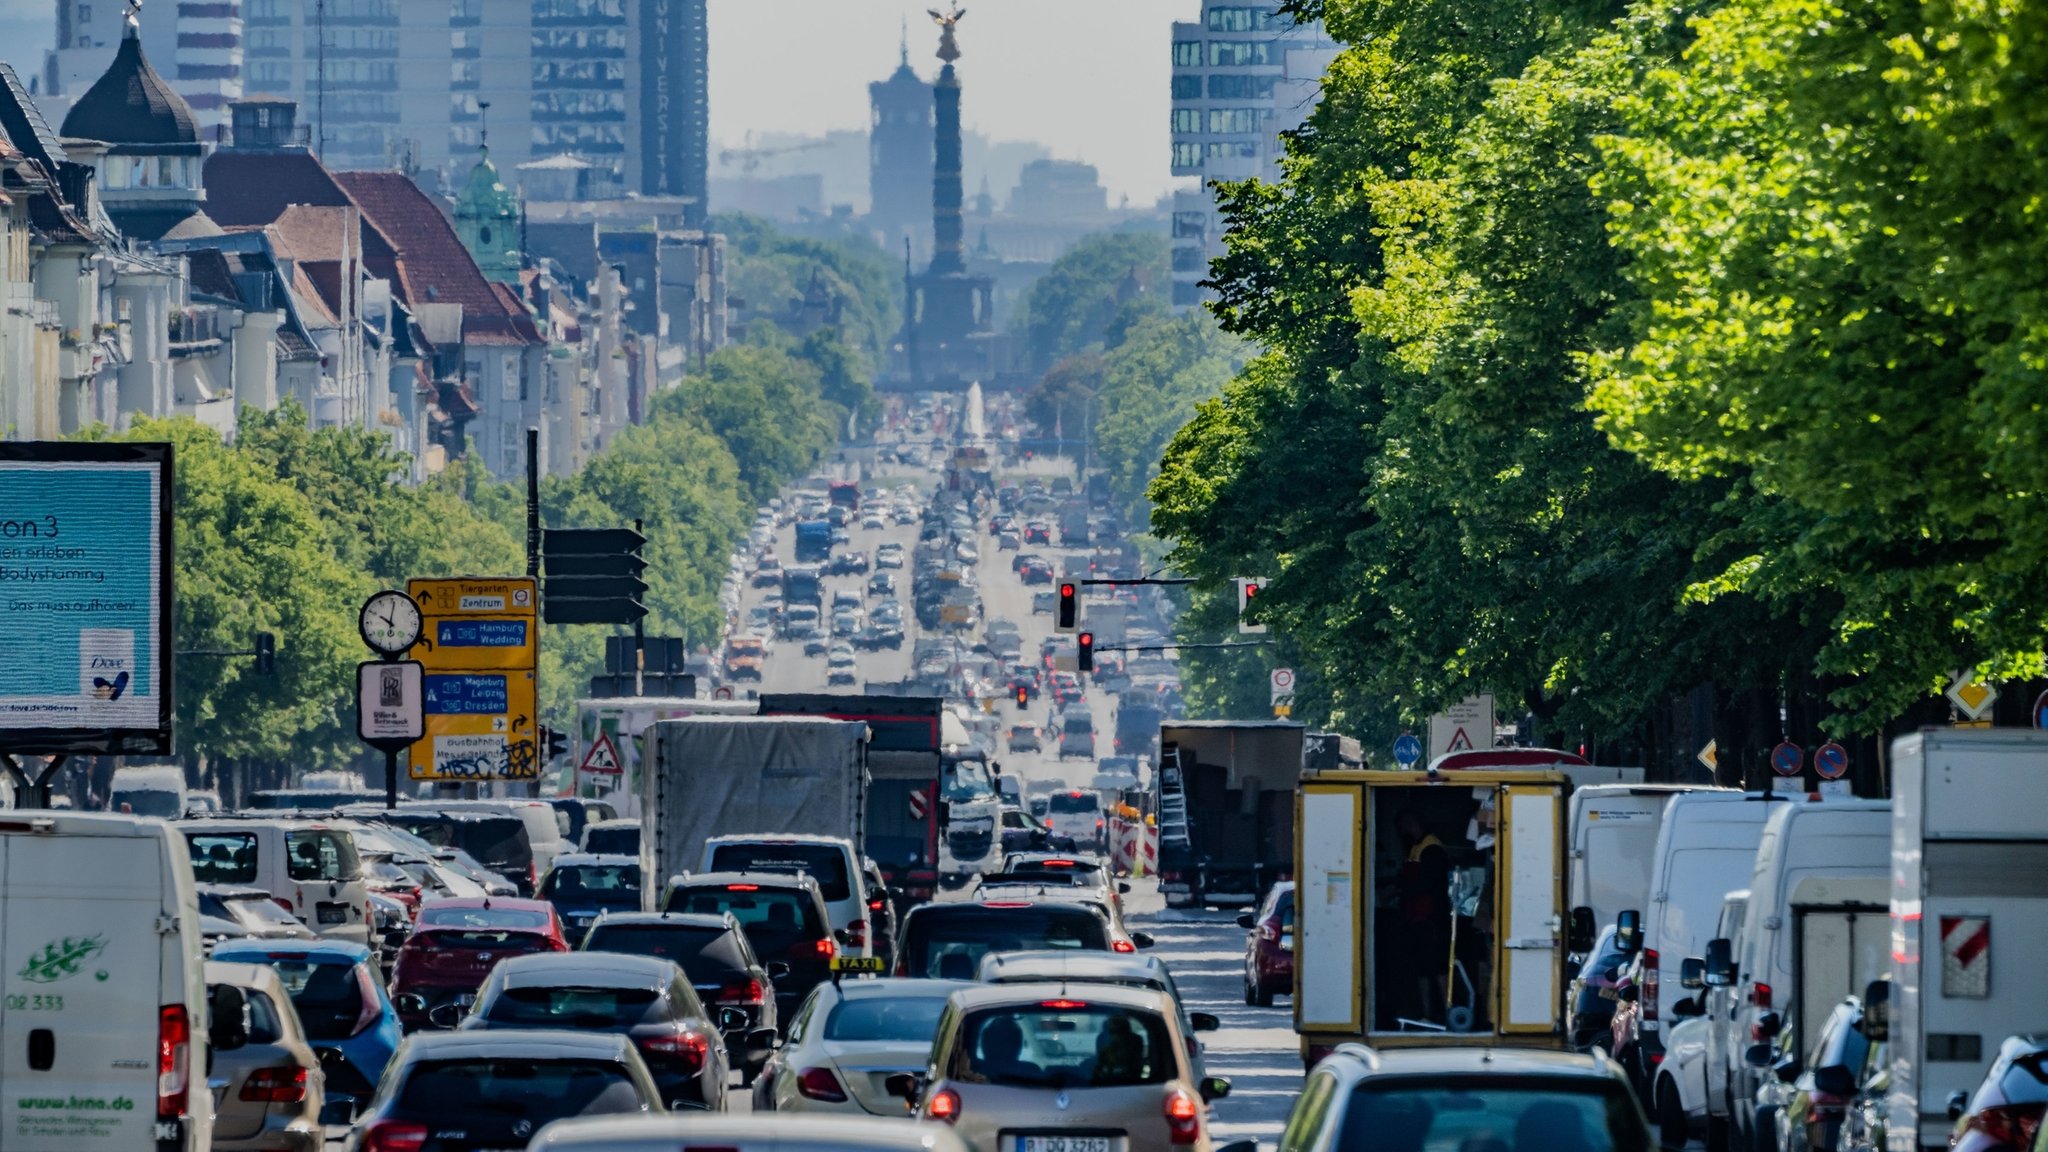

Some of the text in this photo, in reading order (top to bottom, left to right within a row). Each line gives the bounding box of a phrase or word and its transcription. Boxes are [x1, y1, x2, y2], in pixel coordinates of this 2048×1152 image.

[44, 515, 59, 538] 3
[26, 546, 86, 559] erleben
[459, 584, 508, 596] Tiergarten
[461, 598, 503, 608] Zentrum
[479, 624, 524, 635] Hamburg
[481, 635, 522, 645] Wedding
[465, 677, 505, 688] Magdeburg
[471, 689, 506, 700] Leipzig
[465, 701, 505, 711] Dresden
[841, 958, 876, 969] TAXI
[32, 995, 64, 1011] 333
